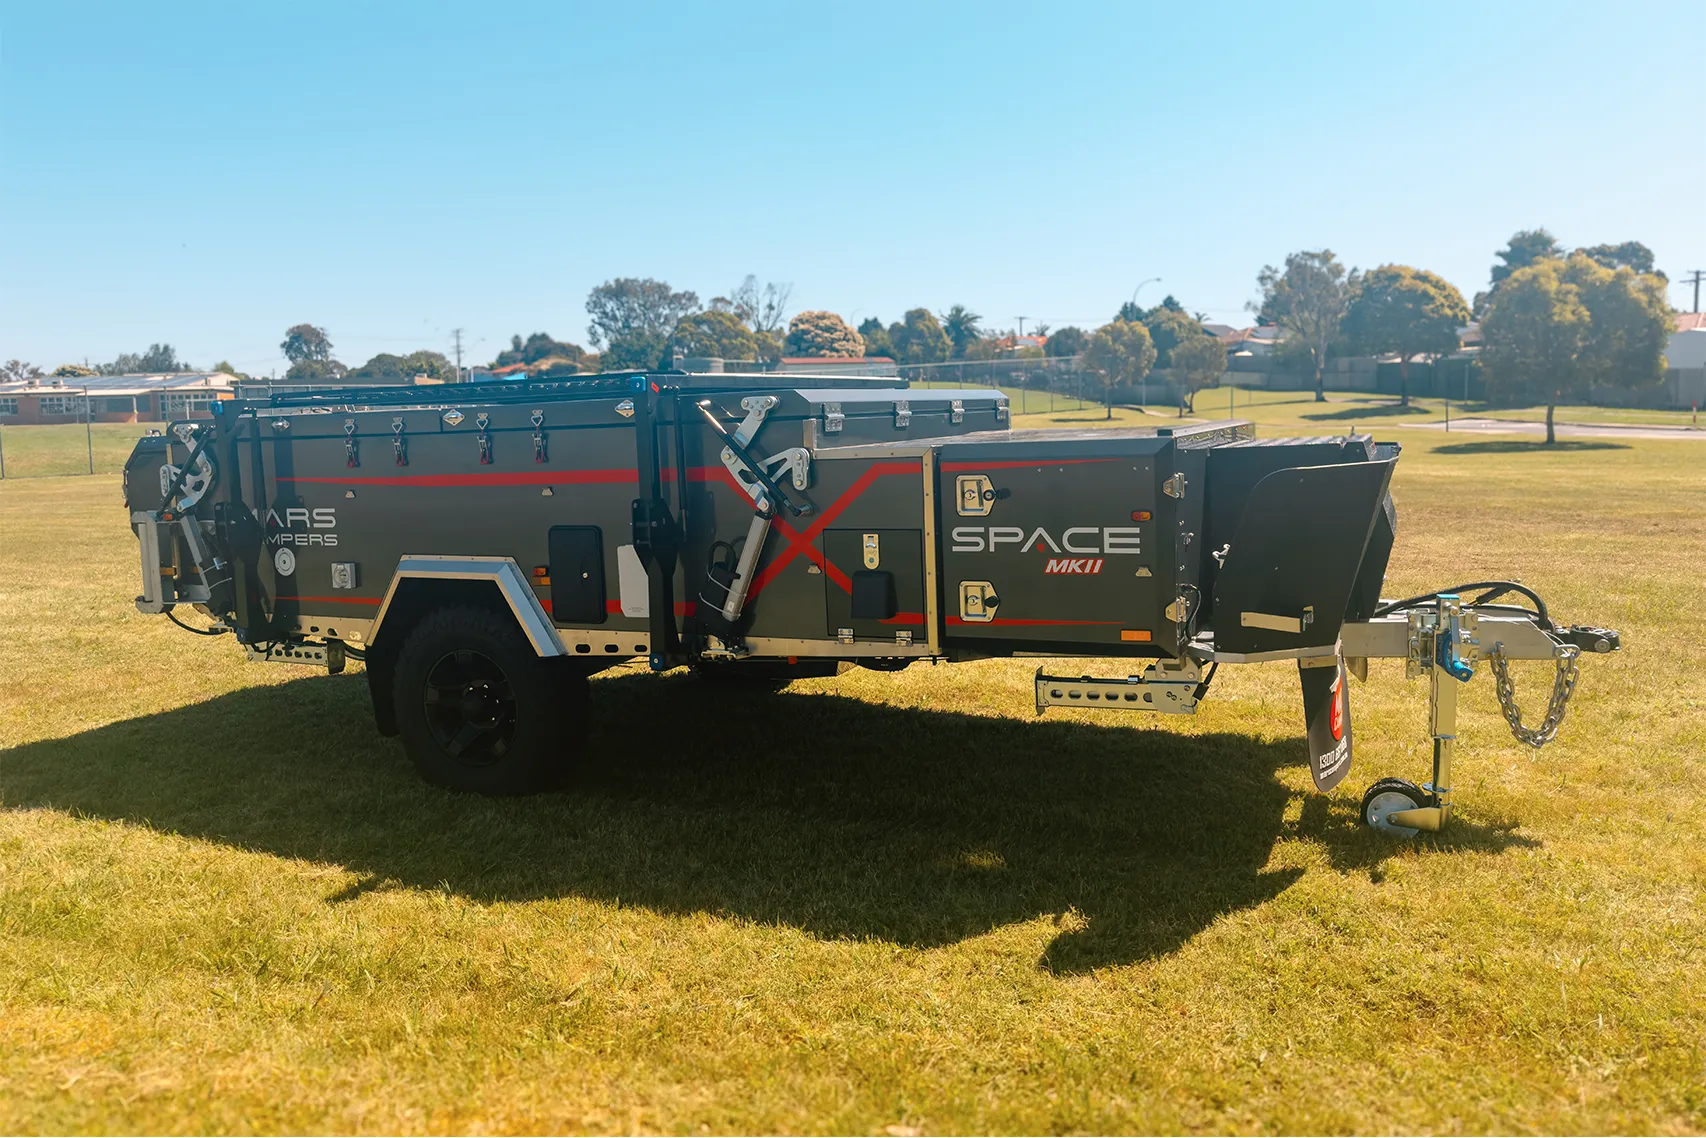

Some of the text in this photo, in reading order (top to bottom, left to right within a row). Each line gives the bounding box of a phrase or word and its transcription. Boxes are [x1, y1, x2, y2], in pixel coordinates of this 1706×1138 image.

[262, 534, 338, 546] MPERS
[951, 527, 1140, 554] SPACE
[1045, 559, 1103, 573] MKII
